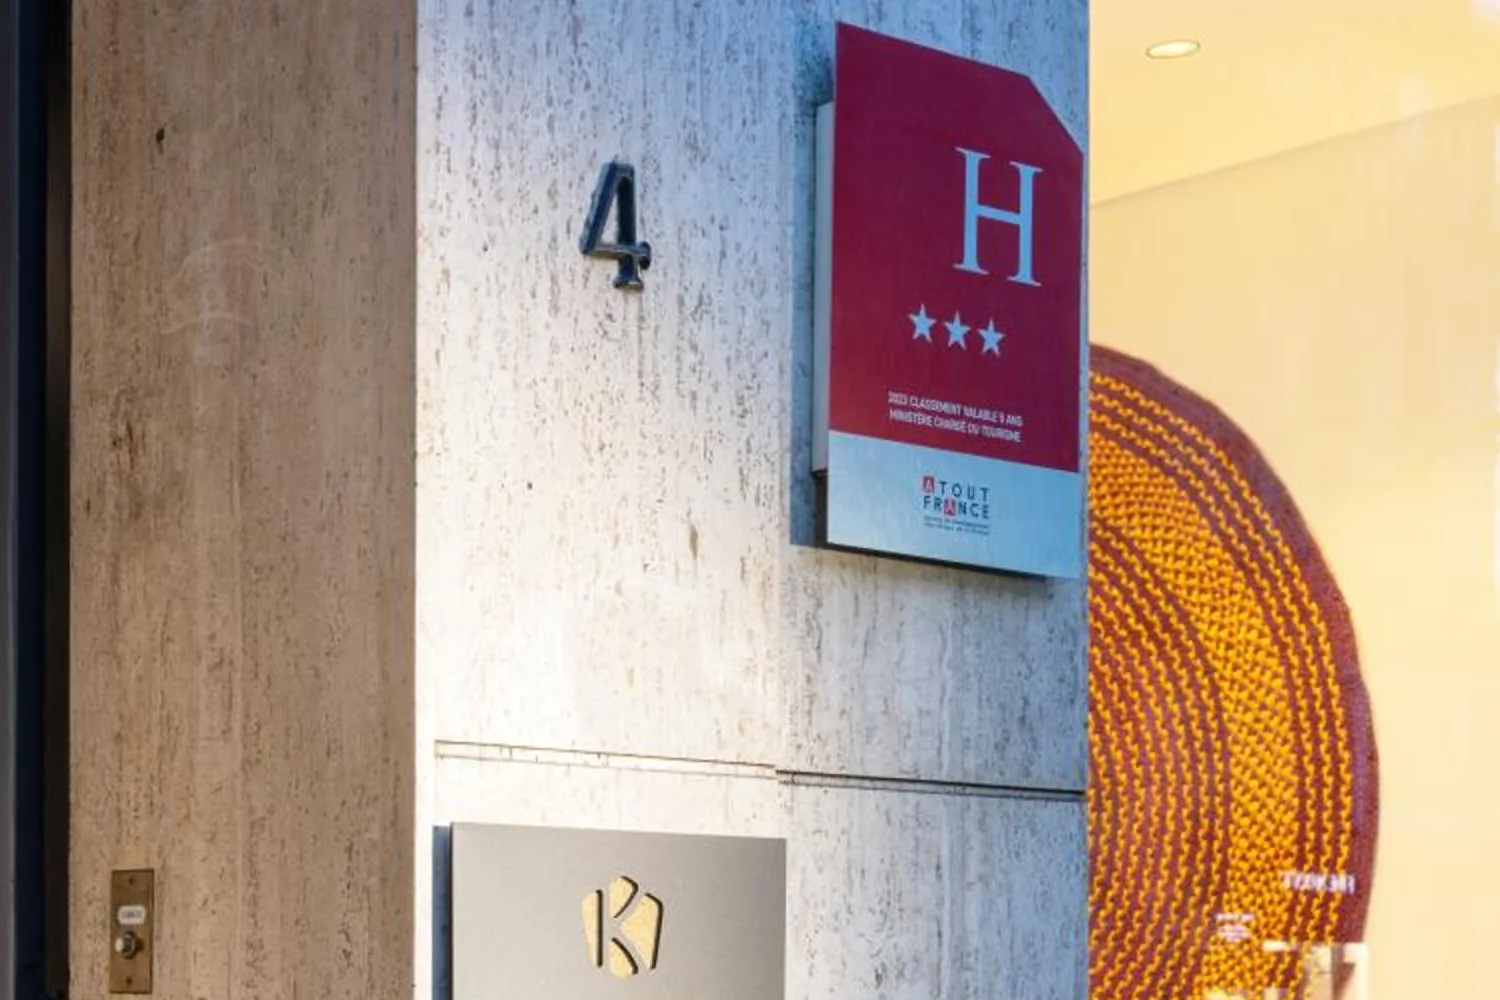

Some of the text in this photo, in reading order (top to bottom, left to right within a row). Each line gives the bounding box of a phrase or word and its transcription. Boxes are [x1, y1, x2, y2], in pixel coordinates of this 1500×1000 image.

[579, 164, 651, 292] 4
[952, 146, 1044, 287] H
[909, 394, 962, 416] CLASSEMENT
[963, 404, 998, 423] VALABLE
[1005, 413, 1024, 427] ANS
[967, 422, 980, 435] DU
[980, 425, 1021, 443] TOURISME
[922, 495, 990, 519] FRANCE
